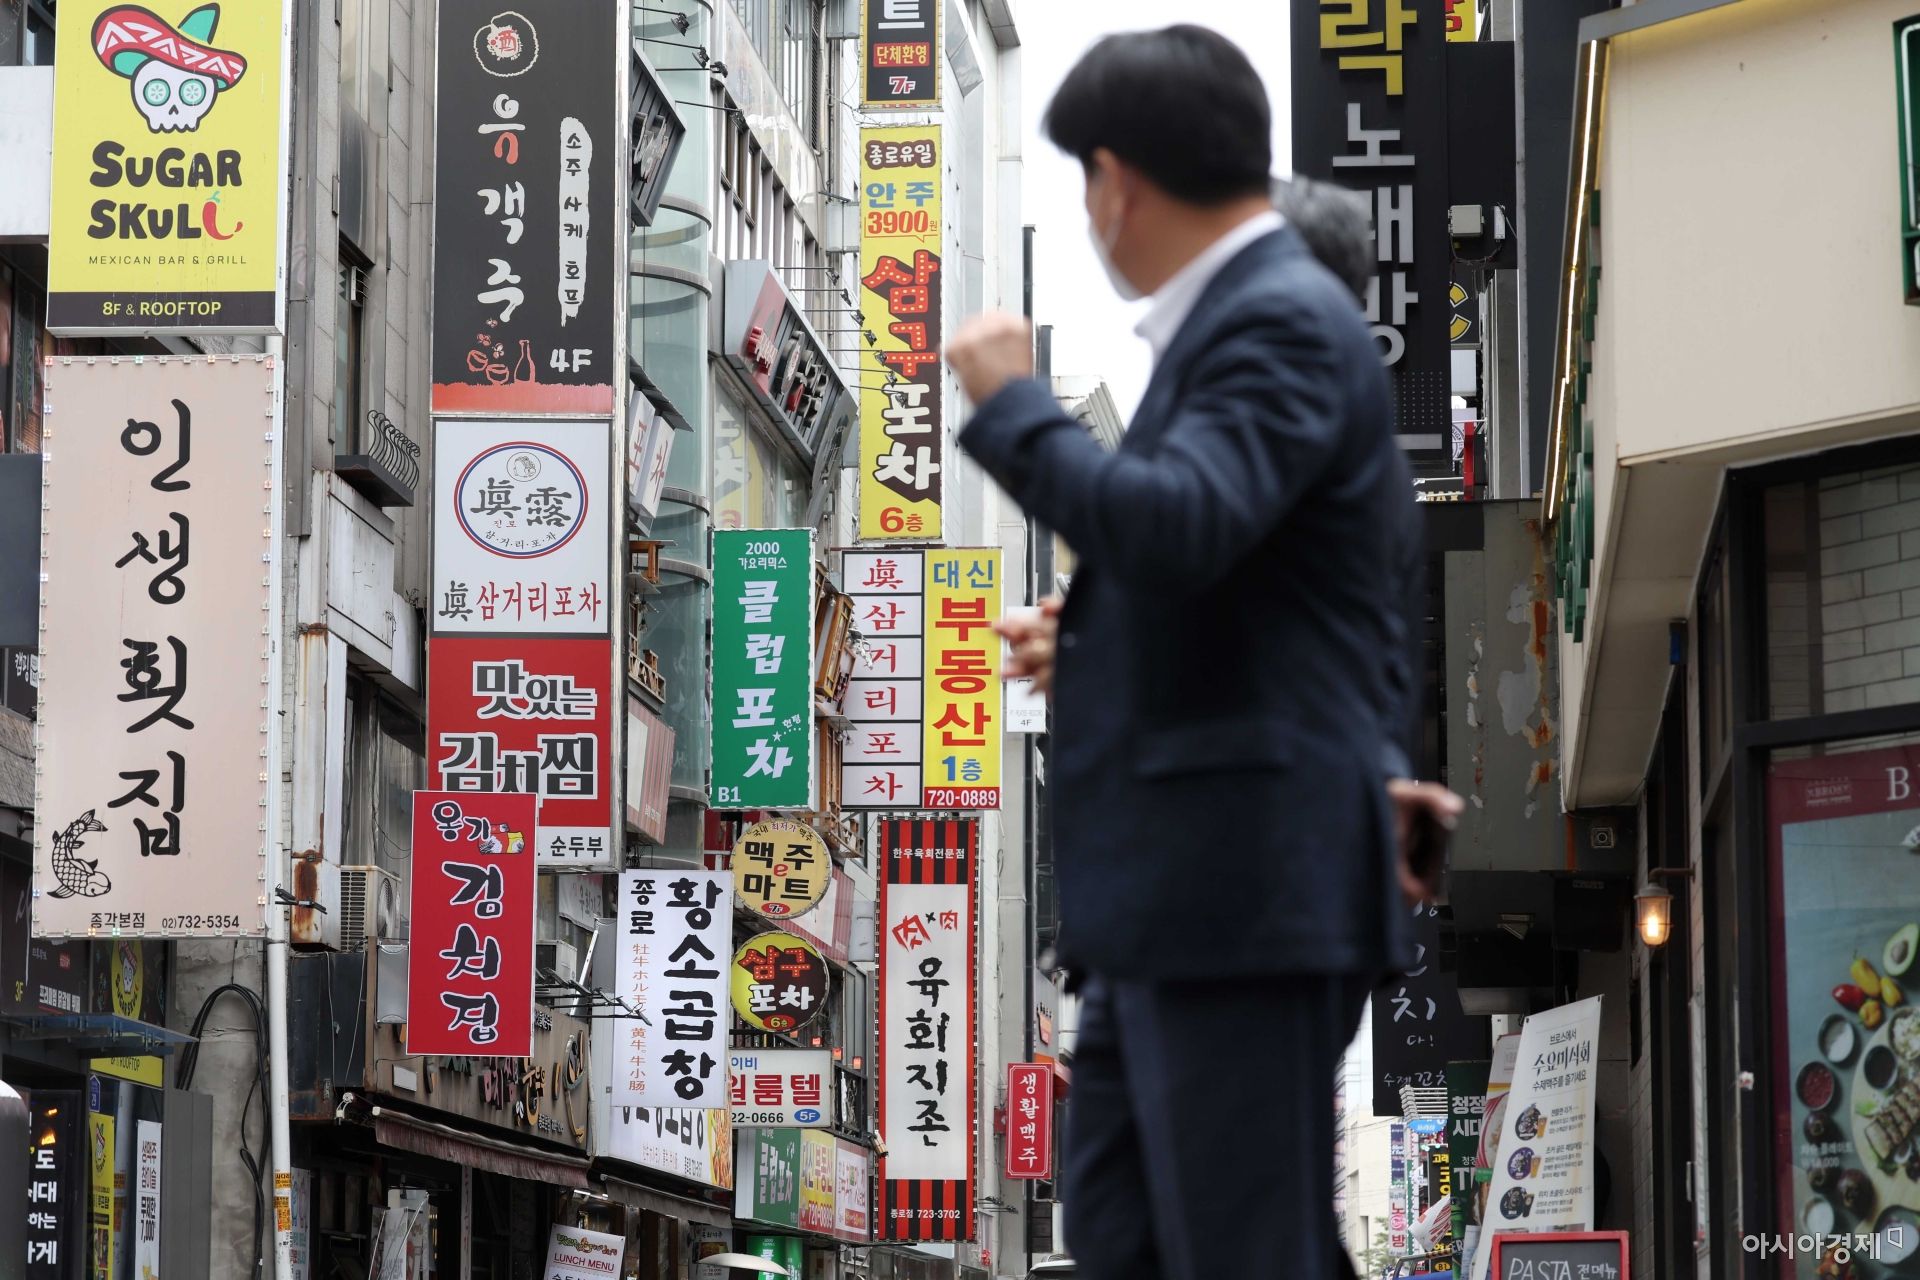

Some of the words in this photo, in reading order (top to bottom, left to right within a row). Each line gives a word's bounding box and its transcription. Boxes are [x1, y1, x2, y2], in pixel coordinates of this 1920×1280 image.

[876, 45, 928, 65] 단체환영
[889, 76, 915, 94] 7F
[565, 133, 582, 176] 소주
[869, 143, 932, 166] 종로유일
[866, 182, 934, 208] 안주
[87, 191, 243, 240] SKULL
[563, 196, 582, 238] 사케
[867, 210, 938, 234] 3900원
[89, 255, 151, 265] MEXICAN
[159, 255, 185, 265] BAR
[192, 255, 200, 265] &
[207, 255, 247, 265] GRILL
[564, 261, 581, 304] 호프
[102, 302, 121, 316] 8F
[126, 304, 135, 316] &
[140, 302, 221, 316] ROOFTOP
[550, 348, 592, 373] 4F
[494, 520, 517, 528] 진로
[879, 506, 923, 533] 6층
[745, 543, 780, 555] 2000
[738, 557, 787, 570] 가요리믹스
[933, 560, 994, 589] 대신
[107, 399, 195, 857] 인생횟집
[732, 581, 793, 779] 클럽포차
[932, 597, 996, 746] 부동산
[473, 660, 597, 720] 맛있는
[438, 731, 598, 802] 김치찜
[941, 756, 982, 782] 1층
[718, 787, 741, 802] B1
[927, 789, 997, 807] 720-0889
[432, 801, 491, 843] 옹기
[551, 836, 602, 857] 순두부
[744, 841, 815, 871] 맥주
[893, 848, 965, 860] 한우육회전문점
[773, 863, 789, 877] e
[743, 874, 812, 901] 마트
[629, 879, 656, 934] 종로
[90, 912, 145, 928] 종각본점
[162, 915, 240, 929] 02)732-5354
[739, 945, 810, 981] 삼구
[661, 877, 723, 1101] 황소곱창
[750, 984, 814, 1013] 포차
[905, 956, 950, 1147] 육회지존
[800, 1111, 816, 1121] 5F
[1017, 1072, 1040, 1169] 생활맥주
[890, 1208, 913, 1219] 종로점
[917, 1209, 960, 1219] 723-3702
[554, 1253, 585, 1265] LUNCH
[587, 1259, 614, 1272] MENU
[1508, 1258, 1572, 1280] PASTA
